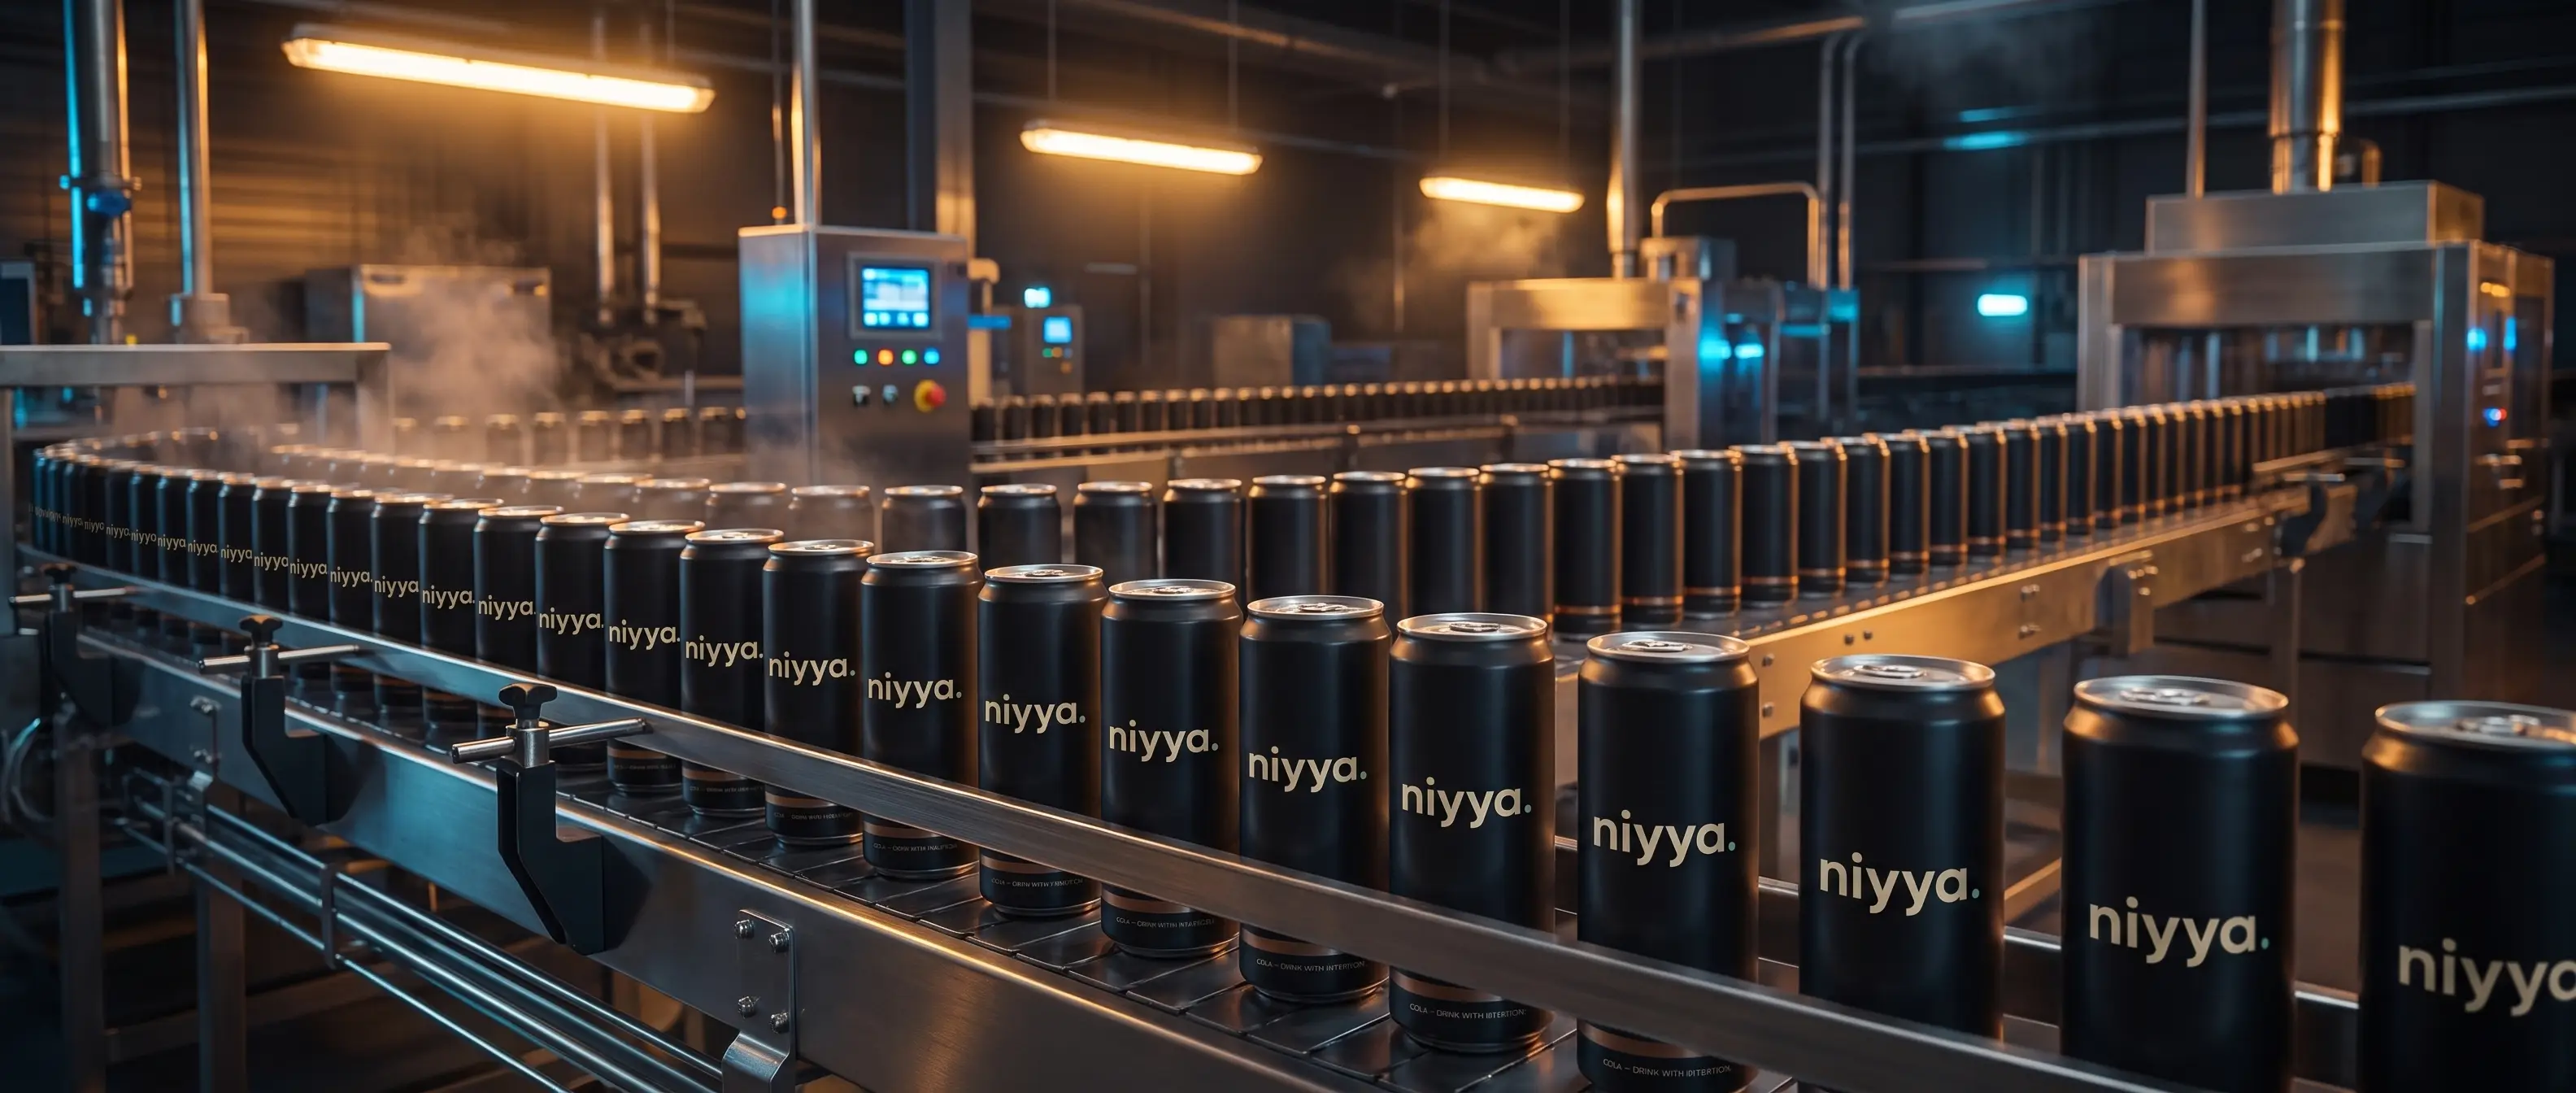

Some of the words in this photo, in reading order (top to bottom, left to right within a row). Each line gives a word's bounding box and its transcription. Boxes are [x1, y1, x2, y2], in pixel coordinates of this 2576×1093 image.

[422, 585, 476, 609] niyya.
[539, 607, 604, 635] niyya.
[609, 620, 680, 650] niyya.
[686, 635, 763, 667] niyya.
[769, 651, 855, 686] niyya.
[868, 672, 961, 708] niyya.
[986, 694, 1086, 734] niyya.
[1110, 720, 1218, 762] niyya.
[1249, 746, 1367, 792] niyya.
[1403, 777, 1531, 828] niyya.
[1594, 810, 1735, 867] niyya.
[1821, 852, 1979, 916] niyya.
[2090, 896, 2269, 967] niyya.
[1256, 958, 1273, 967] COLA
[1409, 1003, 1428, 1014] COLA
[1436, 1009, 1460, 1018] DRINK
[1603, 1058, 1622, 1070] COLA
[1633, 1065, 1660, 1076] DRINK
[1662, 1069, 1684, 1078] WITH
